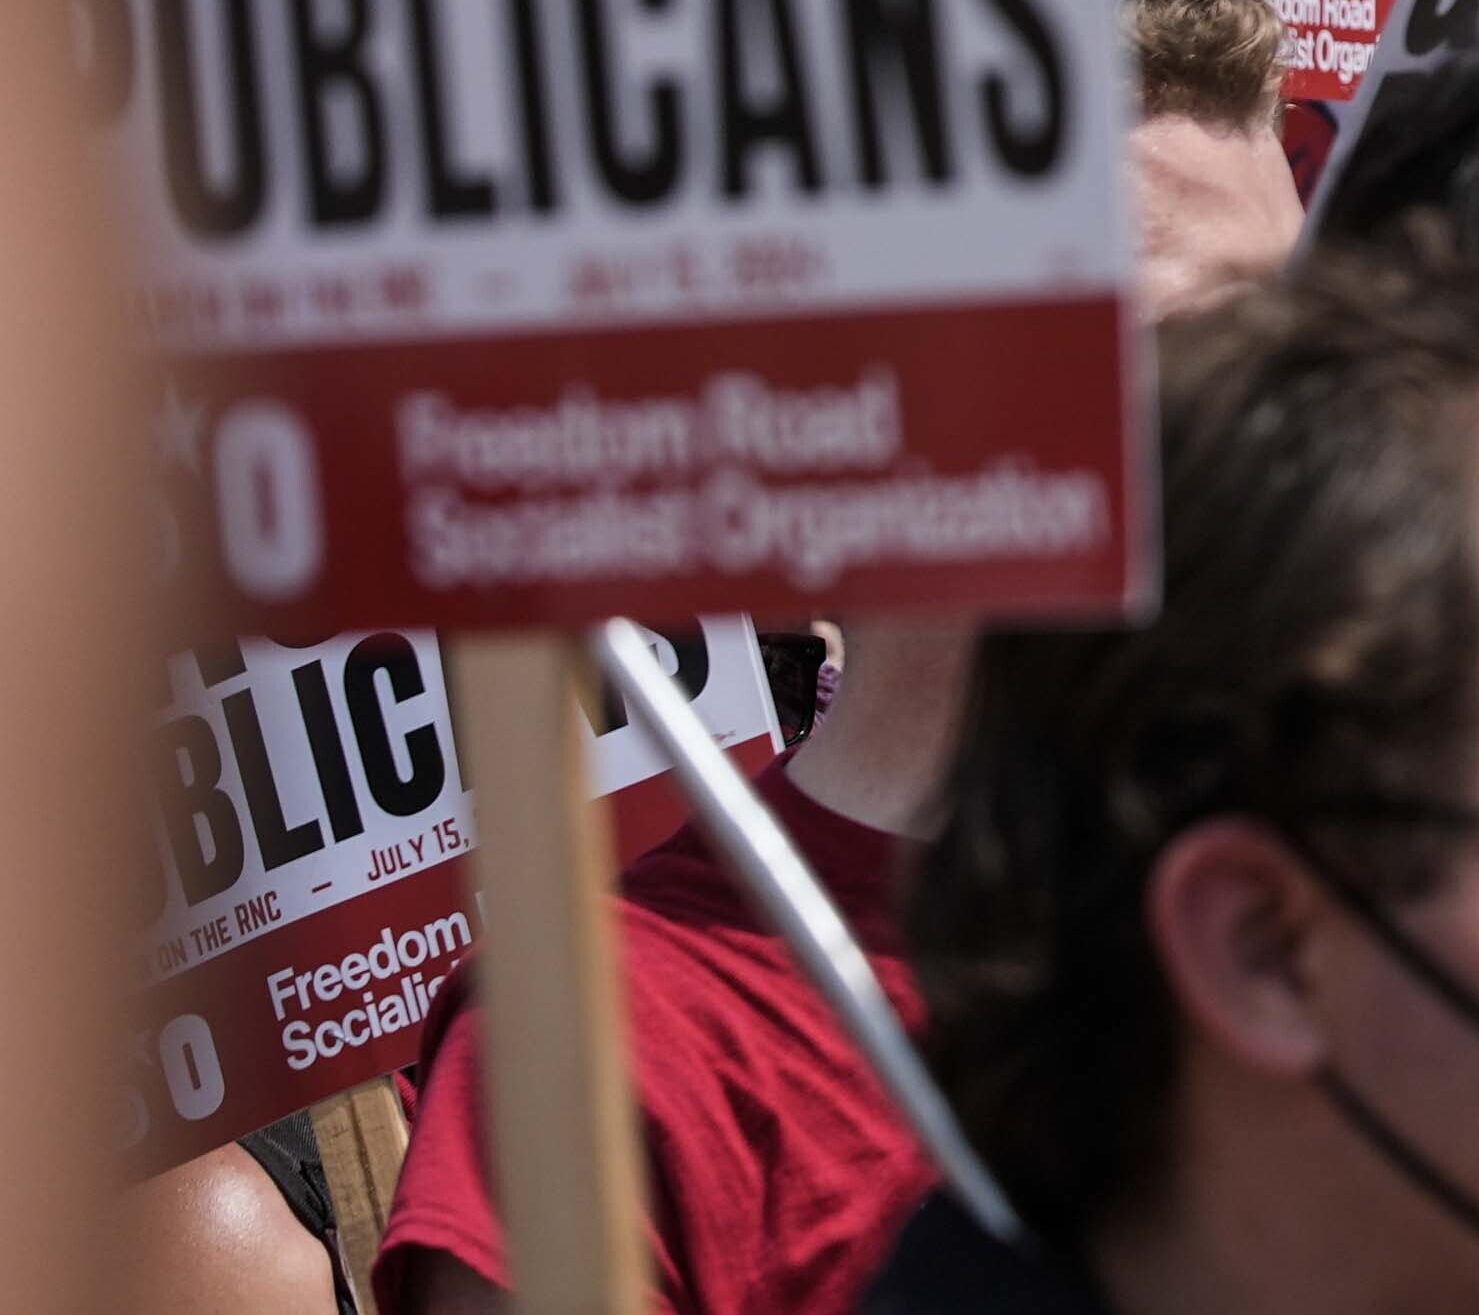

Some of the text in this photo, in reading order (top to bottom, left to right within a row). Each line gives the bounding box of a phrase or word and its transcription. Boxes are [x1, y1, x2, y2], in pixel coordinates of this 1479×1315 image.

[190, 914, 232, 957] THE
[235, 890, 283, 938] RNC
[367, 832, 426, 882] JULY
[431, 817, 472, 855] 15,
[266, 910, 473, 1021] Freedom
[282, 969, 448, 1070] Sociali
